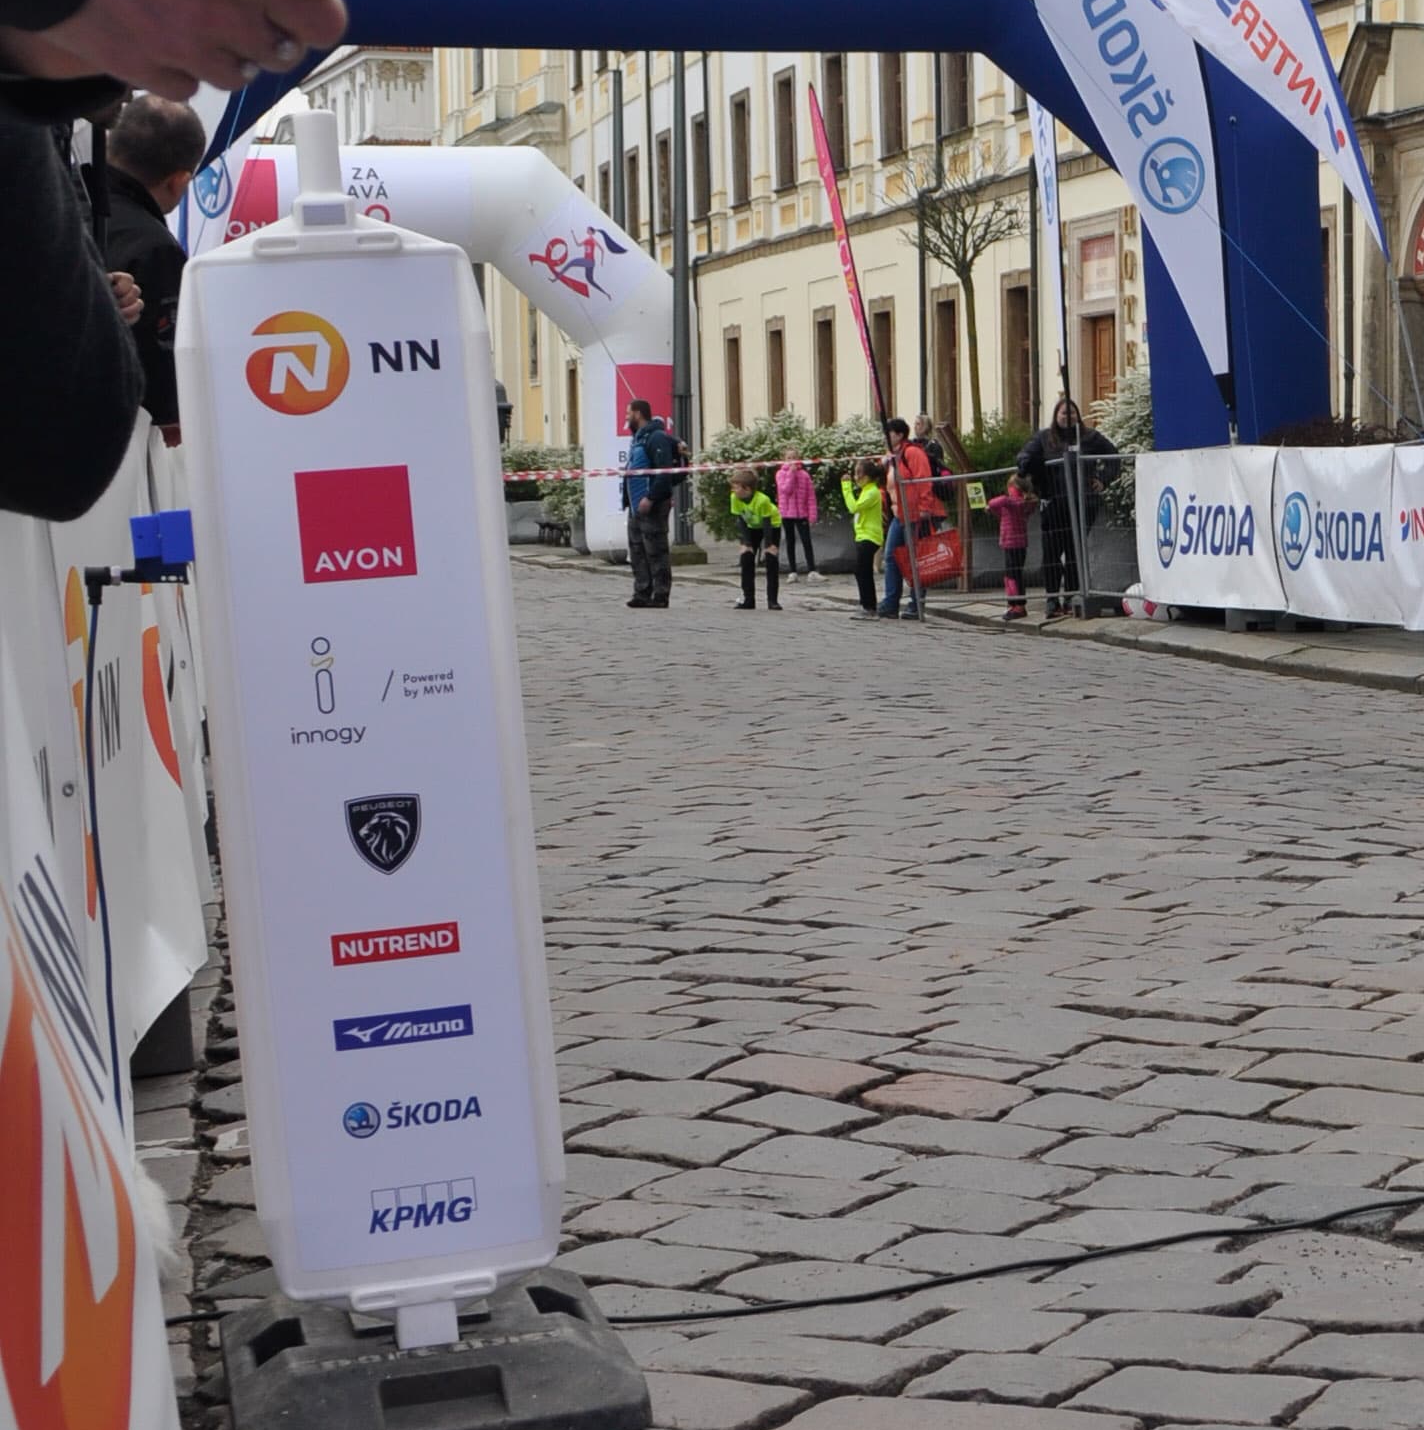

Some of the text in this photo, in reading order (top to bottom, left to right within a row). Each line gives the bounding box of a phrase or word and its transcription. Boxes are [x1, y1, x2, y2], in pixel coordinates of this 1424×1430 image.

[368, 339, 441, 373] NN
[1179, 494, 1255, 556] ŠKODA
[1314, 501, 1385, 561] ŠKODA
[314, 546, 404, 573] AVON
[402, 669, 454, 684] Powered
[404, 683, 455, 699] by MVM
[290, 726, 367, 745] innogy
[351, 800, 413, 813] PEUGEOT
[338, 930, 454, 959] NUTREND
[386, 1096, 482, 1130] ŠKODA
[369, 1195, 473, 1235] KPMG
